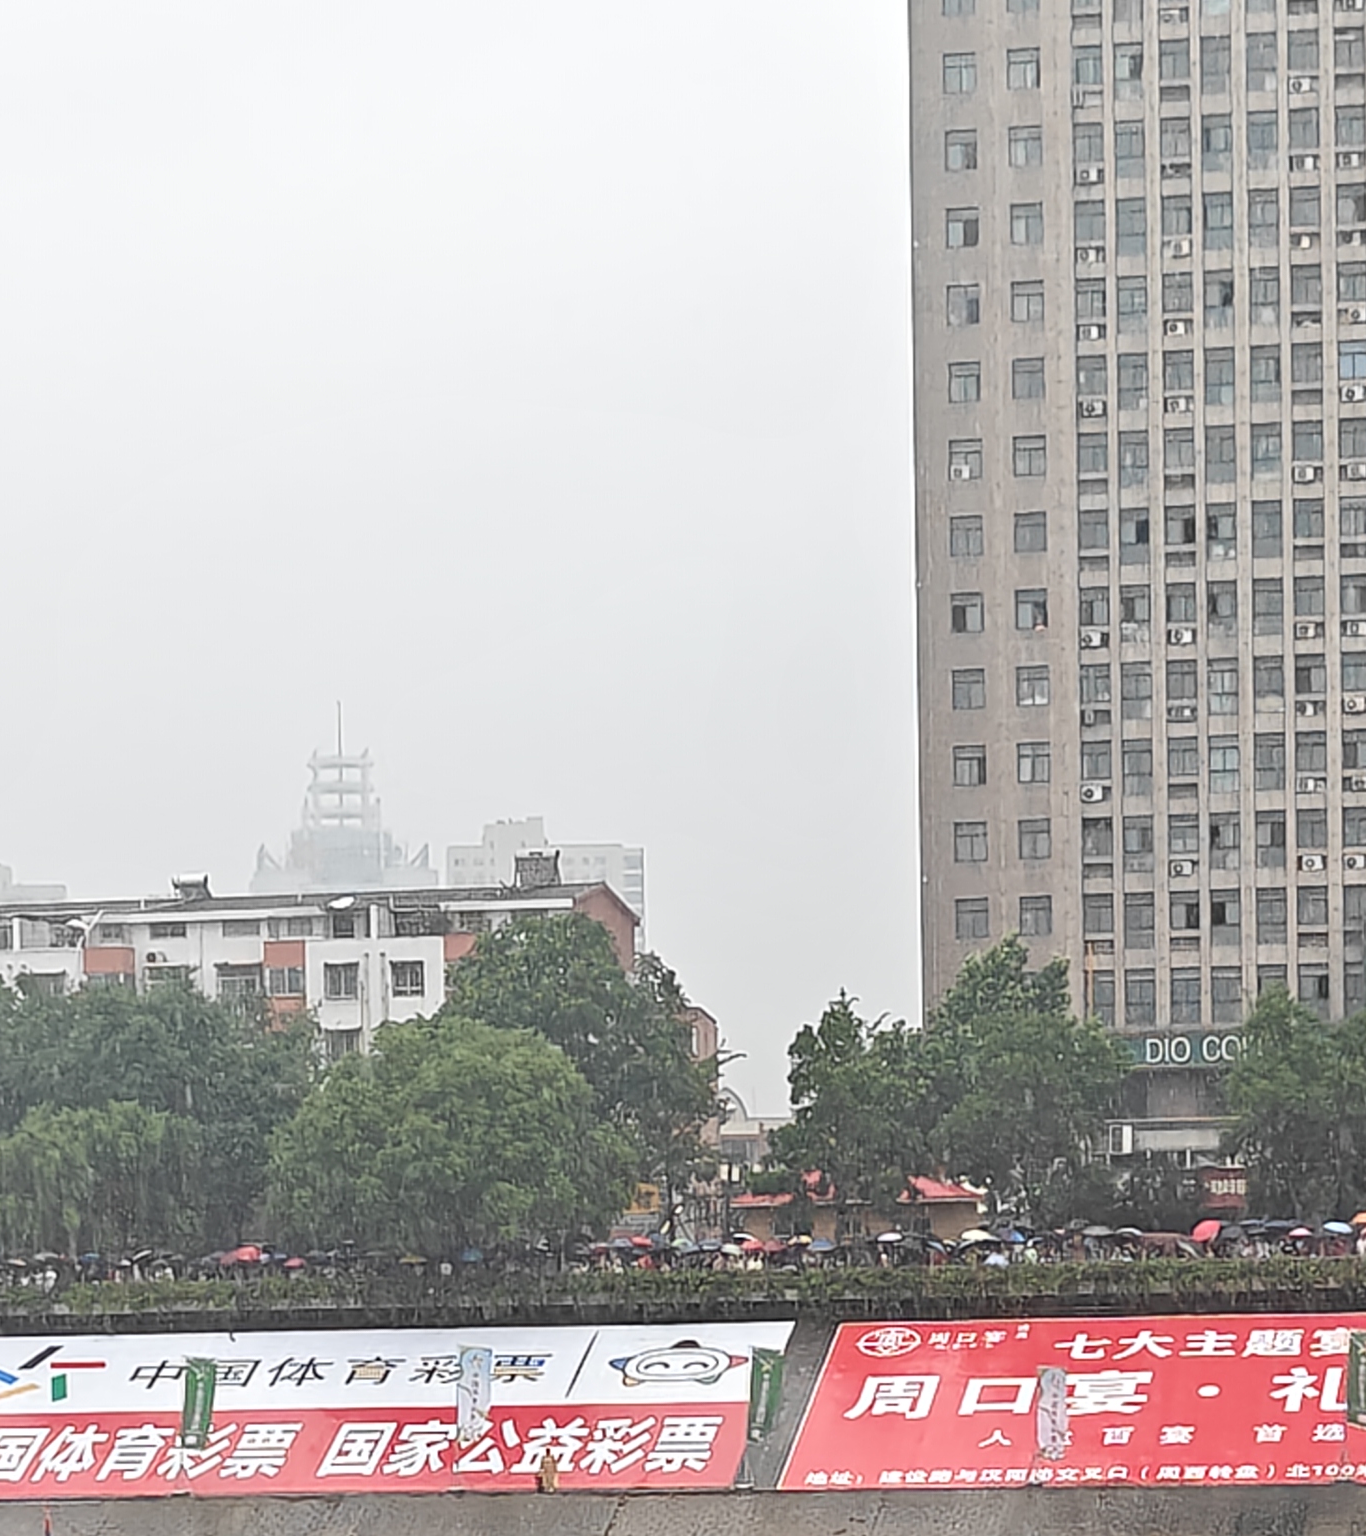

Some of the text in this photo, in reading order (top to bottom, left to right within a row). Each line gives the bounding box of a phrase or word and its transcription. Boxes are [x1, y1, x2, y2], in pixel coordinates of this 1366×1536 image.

[1146, 1036, 1190, 1062] DIO
[315, 1415, 724, 1477] 国家公益彩票
[978, 1424, 1195, 1448] 人百宴
